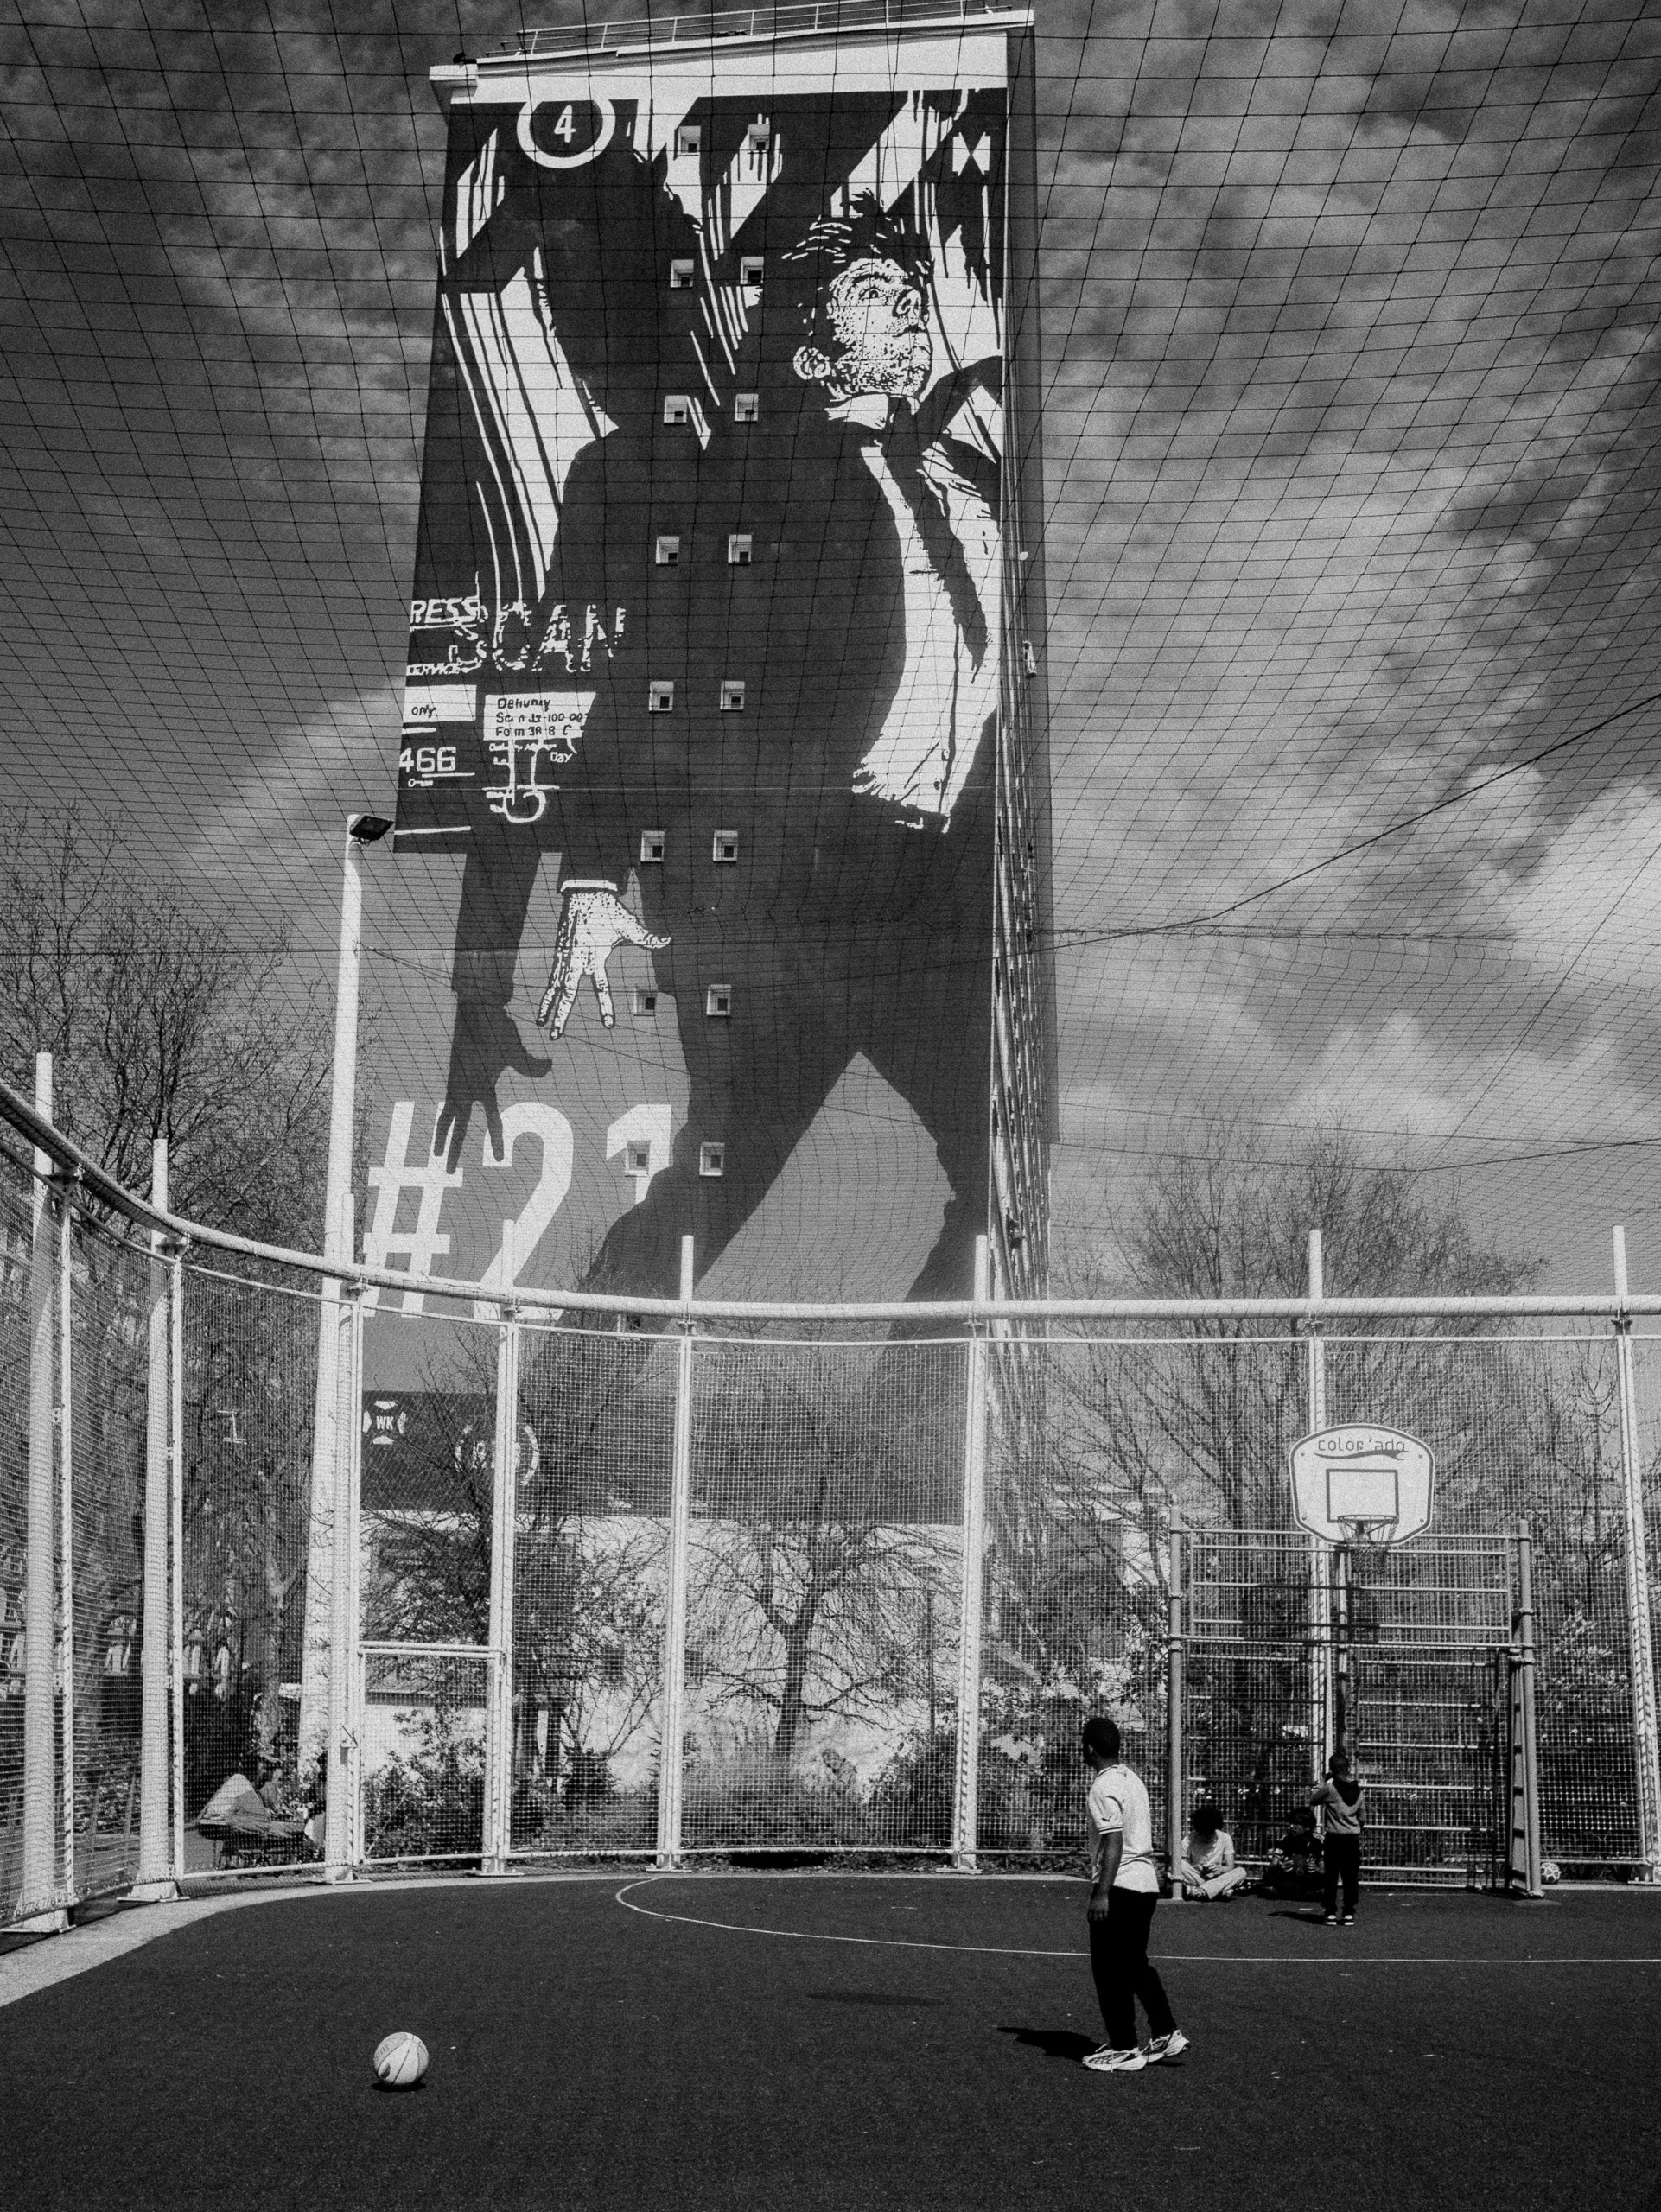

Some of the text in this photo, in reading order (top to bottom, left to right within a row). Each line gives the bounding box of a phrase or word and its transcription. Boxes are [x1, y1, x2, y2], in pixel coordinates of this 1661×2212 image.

[554, 105, 576, 143] 4
[399, 747, 456, 773] 466
[550, 752, 573, 763] Day
[376, 1415, 394, 1430] WK
